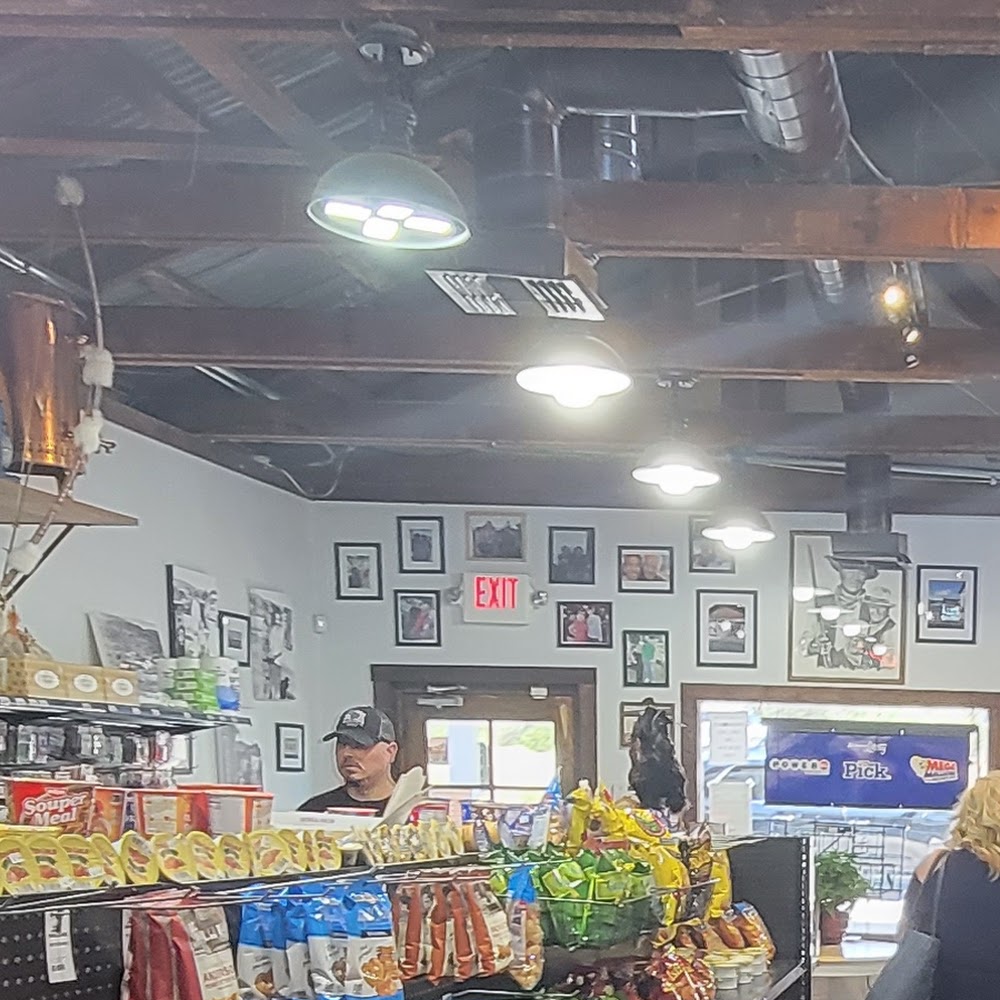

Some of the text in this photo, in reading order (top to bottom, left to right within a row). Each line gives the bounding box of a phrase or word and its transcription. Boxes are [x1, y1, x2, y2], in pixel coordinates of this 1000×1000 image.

[475, 576, 519, 609] EXIT
[844, 761, 887, 780] Pick
[23, 793, 88, 816] Souper
